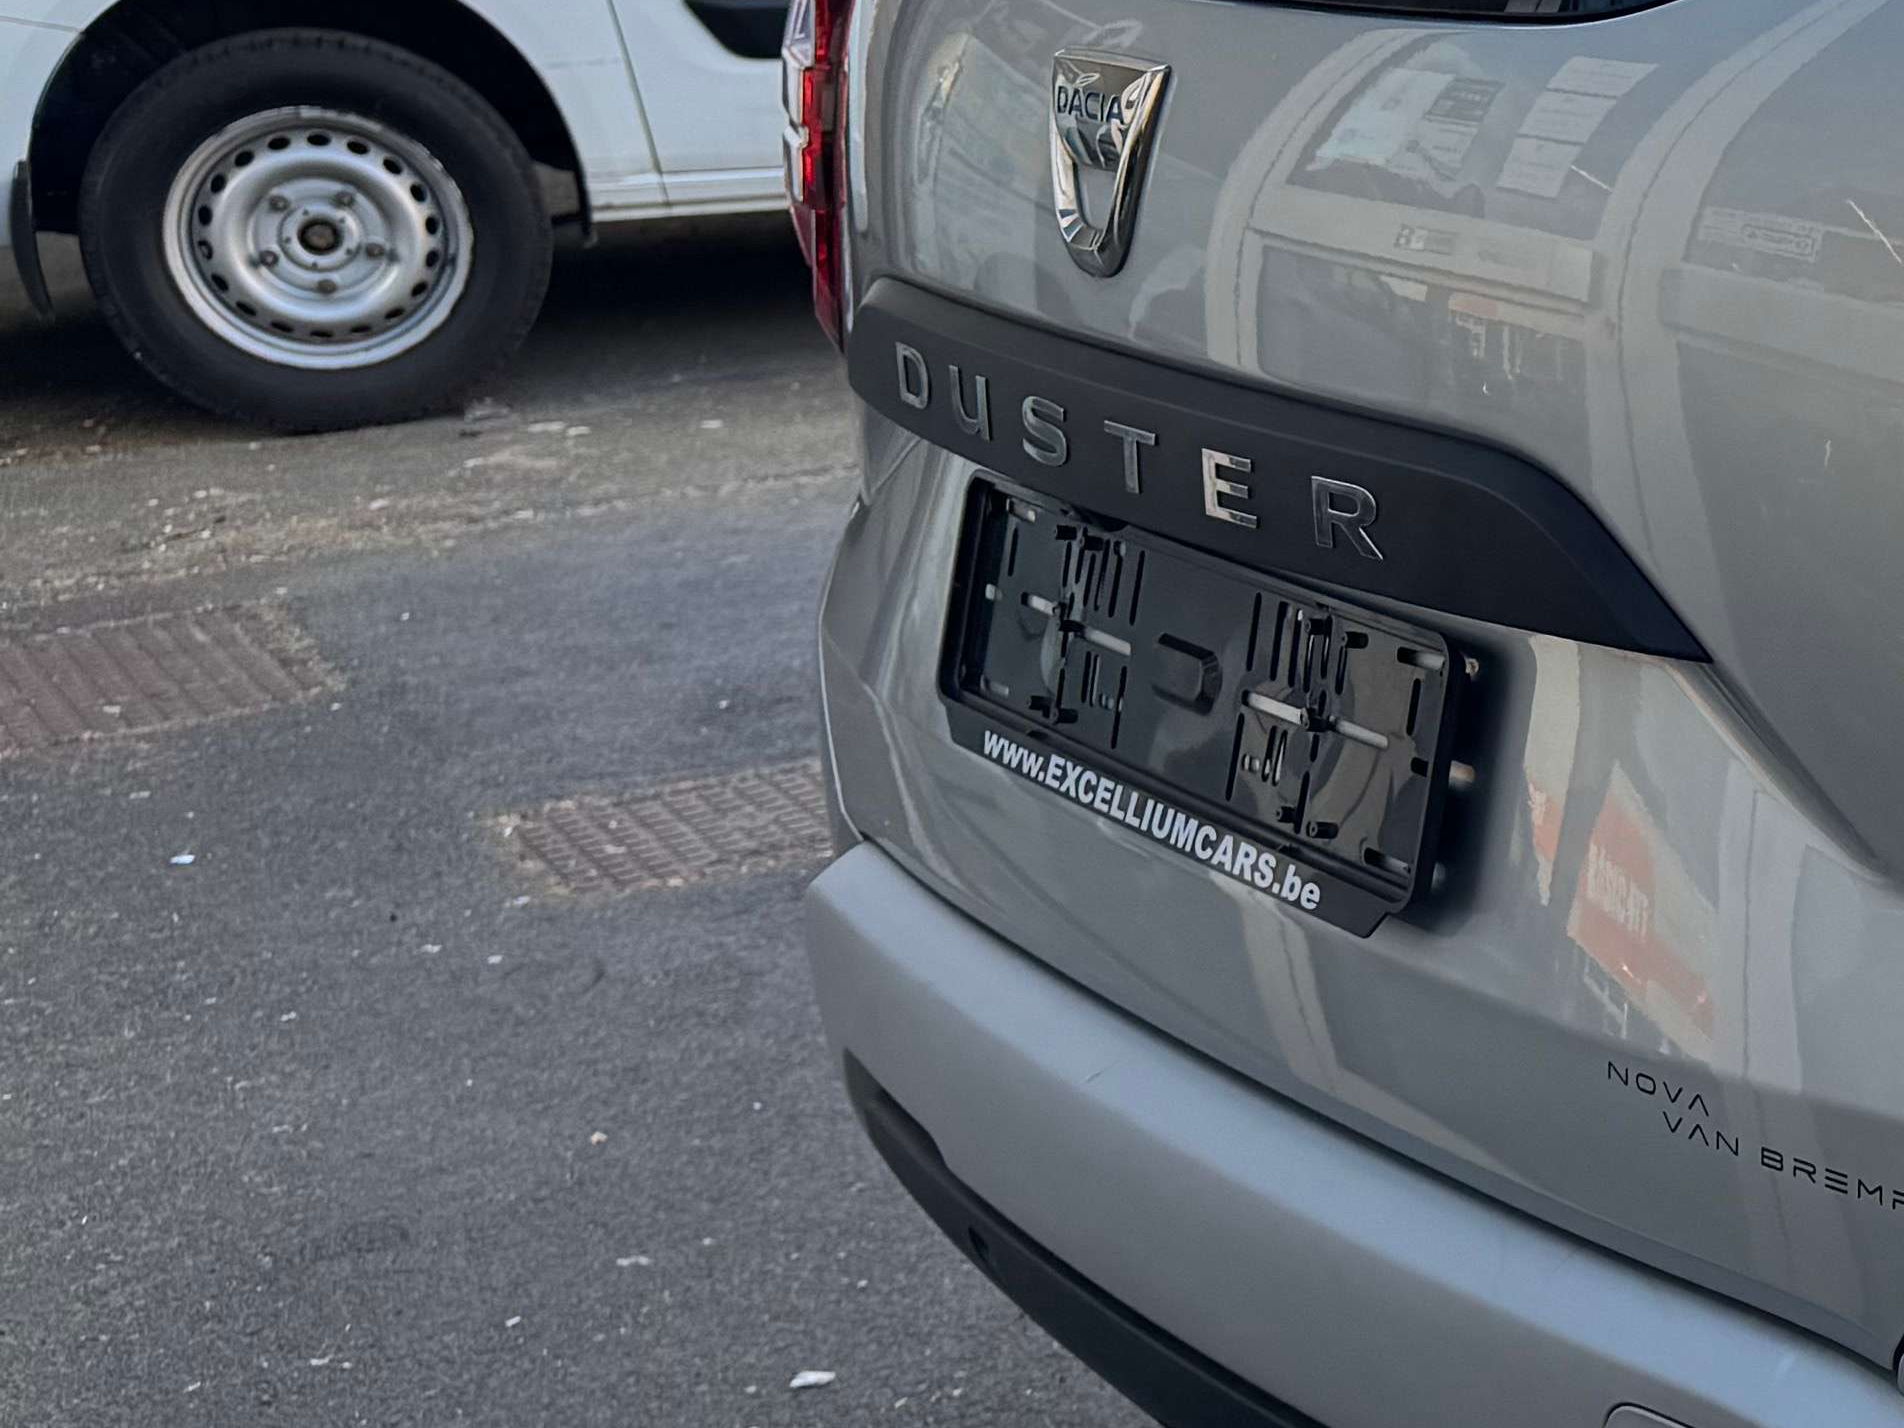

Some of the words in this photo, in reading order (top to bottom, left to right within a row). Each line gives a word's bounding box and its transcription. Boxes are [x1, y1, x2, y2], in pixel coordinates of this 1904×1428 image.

[1054, 80, 1126, 126] DACIA
[894, 342, 1385, 562] DUSTER
[982, 729, 1321, 912] www.EXCELLIUMCARS.be
[1606, 1060, 1710, 1117] NOVA
[1662, 1110, 1740, 1157] VAN
